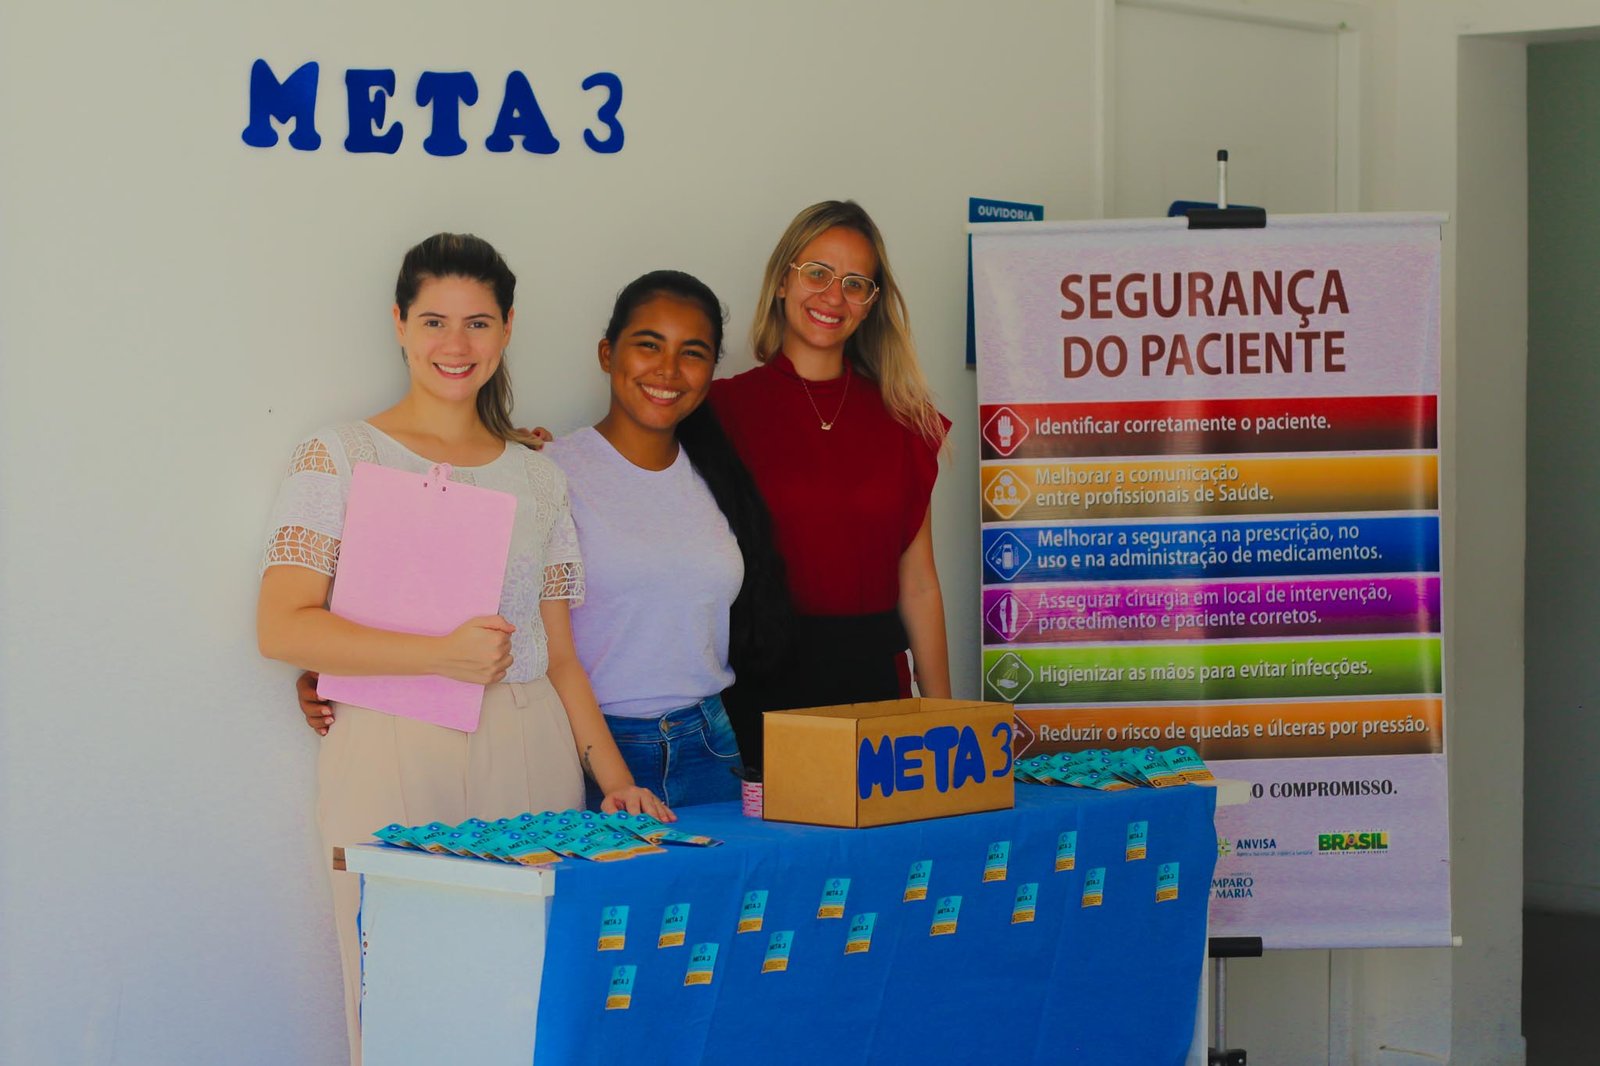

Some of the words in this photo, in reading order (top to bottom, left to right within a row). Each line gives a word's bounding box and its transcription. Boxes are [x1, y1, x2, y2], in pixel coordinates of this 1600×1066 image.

[241, 58, 561, 157] META
[581, 71, 625, 154] 3
[978, 205, 1034, 220] OUVIDORIA
[1060, 269, 1350, 329] SEGURANÇA
[1062, 335, 1128, 379] DO
[1142, 330, 1347, 377] PACIENTE
[1035, 416, 1120, 435] Identificar
[1124, 416, 1237, 433] corretamente
[1241, 417, 1251, 431] o
[1256, 412, 1331, 434] paciente.
[1035, 467, 1112, 485] Melhorar
[1116, 470, 1126, 483] a
[1129, 464, 1239, 485] comunicação
[1036, 490, 1080, 506] entre
[1085, 486, 1189, 509] profissionais
[1194, 484, 1215, 502] de
[1219, 482, 1274, 502] Saúde.
[1038, 529, 1113, 547] Melhorar
[1118, 532, 1127, 545] a
[1132, 529, 1217, 549] segurança
[1222, 529, 1240, 543] na
[1246, 523, 1334, 546] prescrição,
[1339, 525, 1360, 539] no
[1038, 554, 1067, 569] uso
[1071, 554, 1081, 567] e
[1086, 553, 1105, 567] na
[1110, 547, 1228, 569] administração
[1232, 546, 1252, 563] de
[1257, 544, 1383, 562] medicamentos.
[1038, 591, 1122, 612] Assegurar
[1126, 589, 1189, 610] cirurgia
[1194, 591, 1218, 605] em
[1224, 585, 1261, 604] local
[1266, 585, 1286, 603] de
[1290, 583, 1392, 605] intervenção,
[1038, 610, 1156, 634] procedimento
[1161, 613, 1170, 627] e
[1175, 609, 1246, 631] paciente
[1250, 609, 1322, 625] corretos.
[1040, 665, 1125, 687] Higienizar
[1128, 667, 1146, 681] as
[1151, 662, 1195, 680] mãos
[1200, 664, 1236, 683] para
[1240, 660, 1287, 678] evitar
[1291, 657, 1373, 680] infecções.
[1039, 723, 1103, 742] Reduzir
[1107, 725, 1117, 740] o
[1122, 723, 1161, 740] risco
[1165, 721, 1186, 739] de
[1190, 720, 1249, 743] quedas
[1254, 722, 1263, 736] e
[1267, 719, 1326, 736] úlceras
[1330, 720, 1359, 739] por
[1362, 715, 1430, 738] pressão.
[858, 725, 986, 800] META
[991, 722, 1013, 778] 3
[1250, 783, 1264, 798] O
[1270, 779, 1398, 798] COMPROMISSO.
[1236, 838, 1277, 850] ANVISA
[1318, 832, 1388, 851] BRASIL
[1212, 877, 1254, 888] MPARO
[1216, 888, 1253, 899] MARIA
